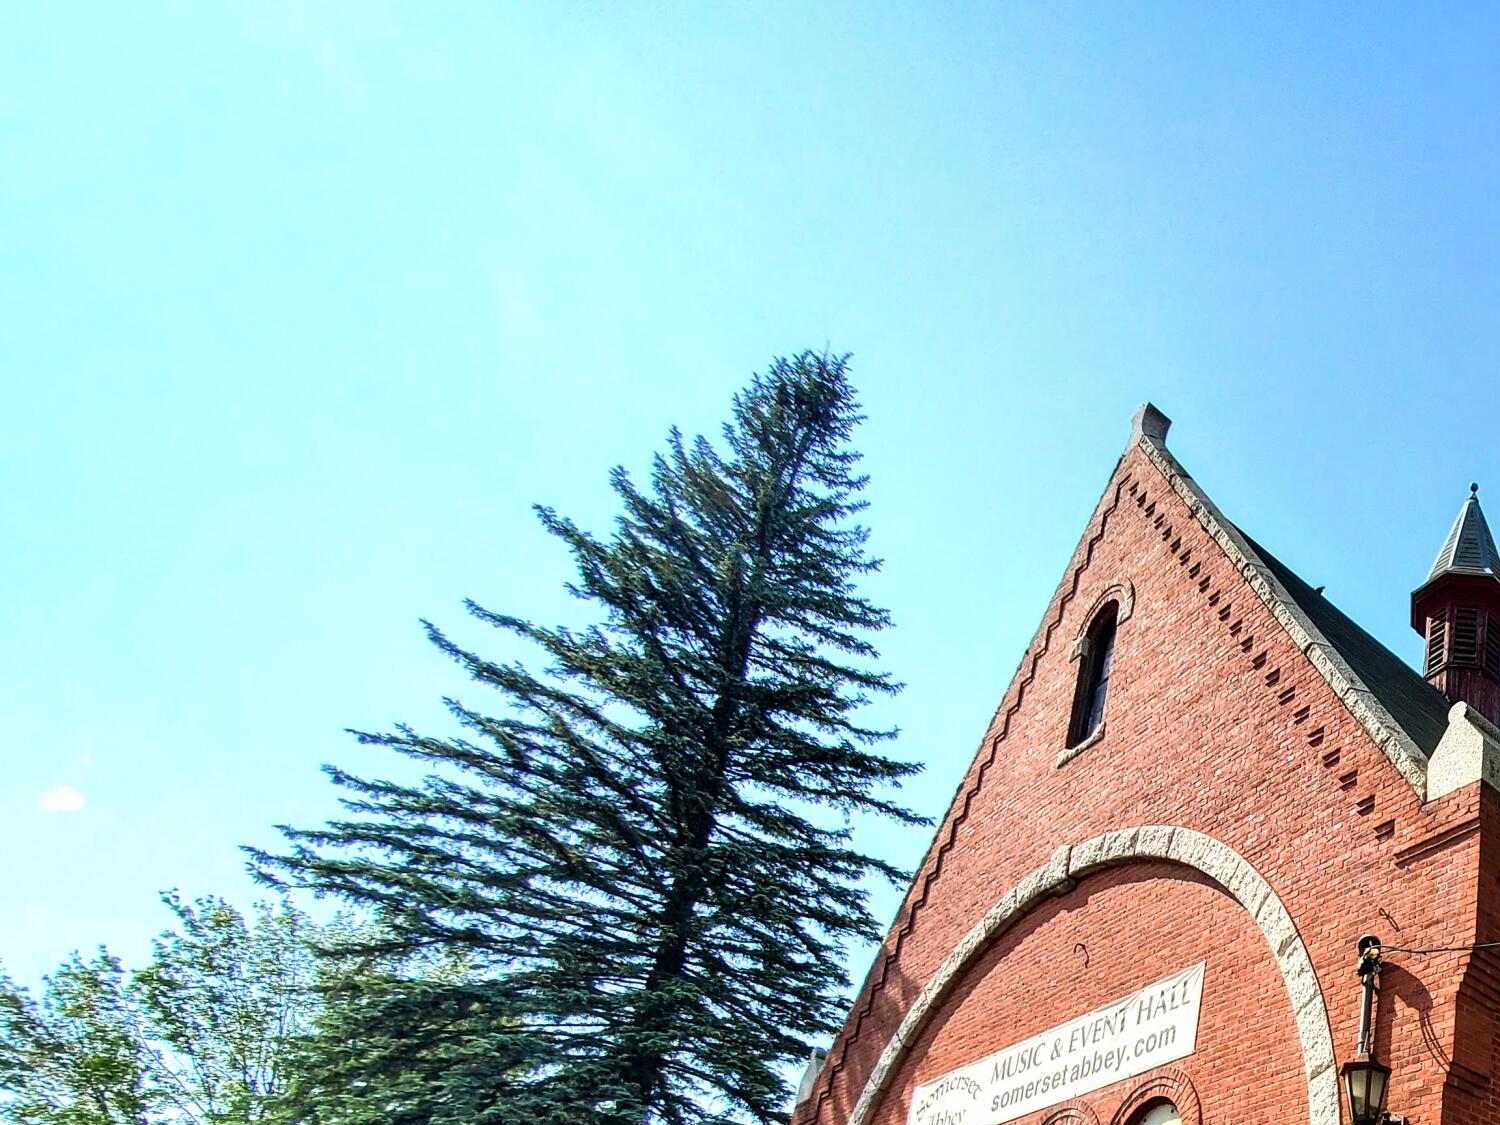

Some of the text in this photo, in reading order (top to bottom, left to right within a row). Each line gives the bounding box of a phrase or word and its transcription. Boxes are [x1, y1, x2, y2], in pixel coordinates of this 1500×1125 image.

[990, 979, 1191, 1084] MUSIC & EVENT HALL
[991, 1024, 1177, 1112] somersetabbey.com
